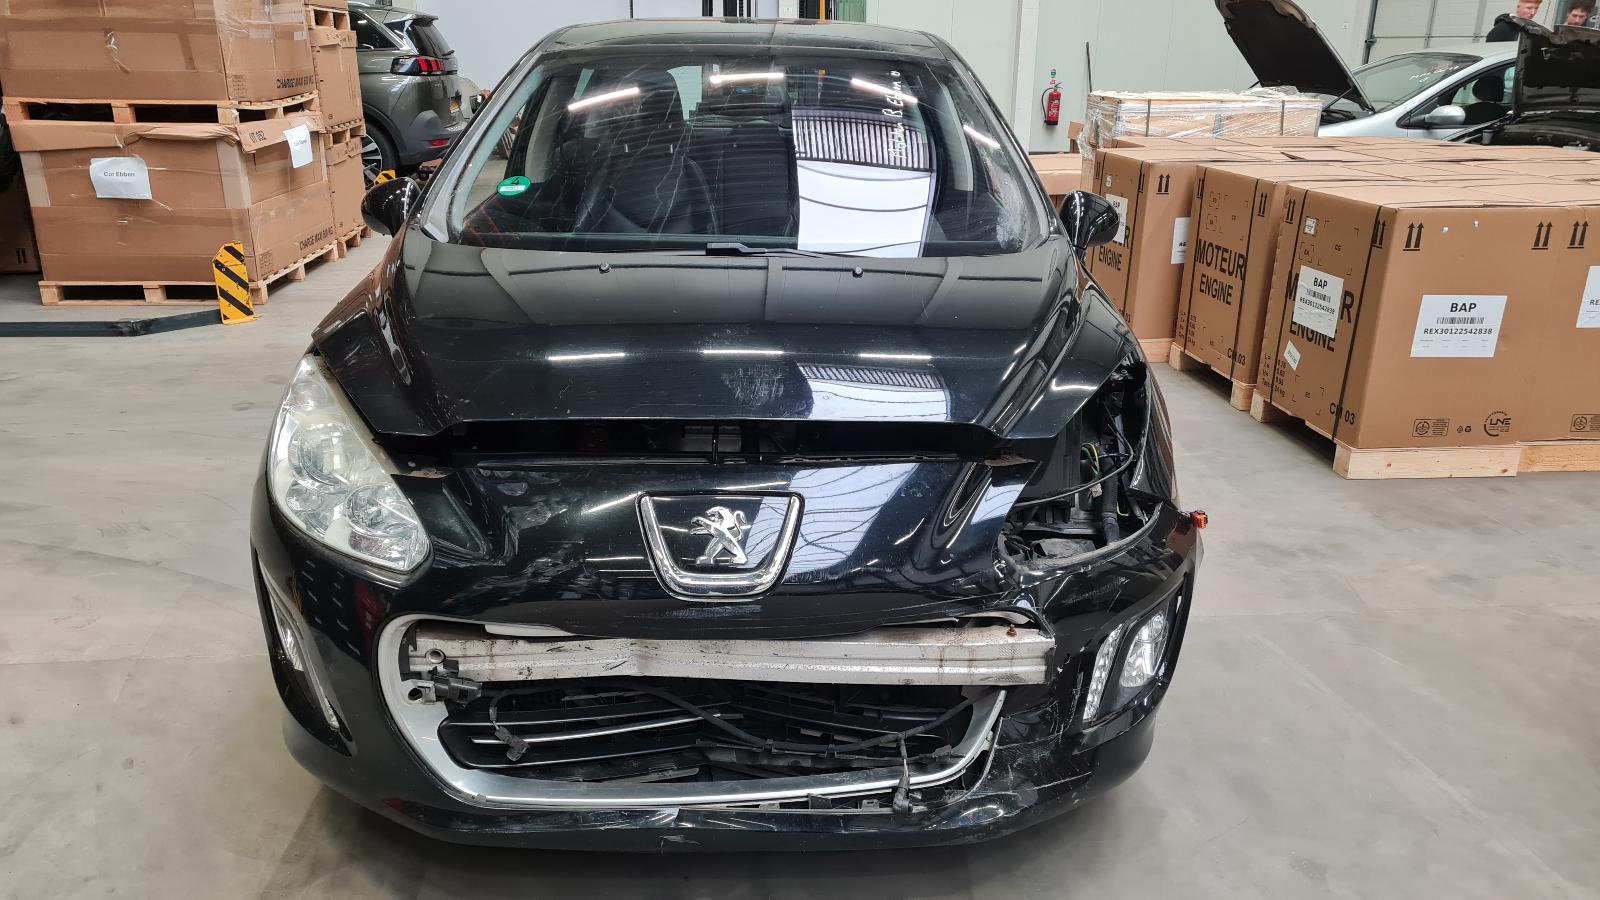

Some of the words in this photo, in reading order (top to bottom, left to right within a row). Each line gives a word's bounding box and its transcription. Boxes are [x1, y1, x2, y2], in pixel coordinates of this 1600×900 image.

[510, 176, 520, 185] 4
[1098, 246, 1122, 271] ENGINE
[1196, 238, 1247, 280] MOTEUR
[1200, 272, 1234, 306] ENGINE
[1314, 276, 1328, 290] BAP
[1450, 302, 1477, 312] BAP
[1344, 410, 1355, 425] 03
